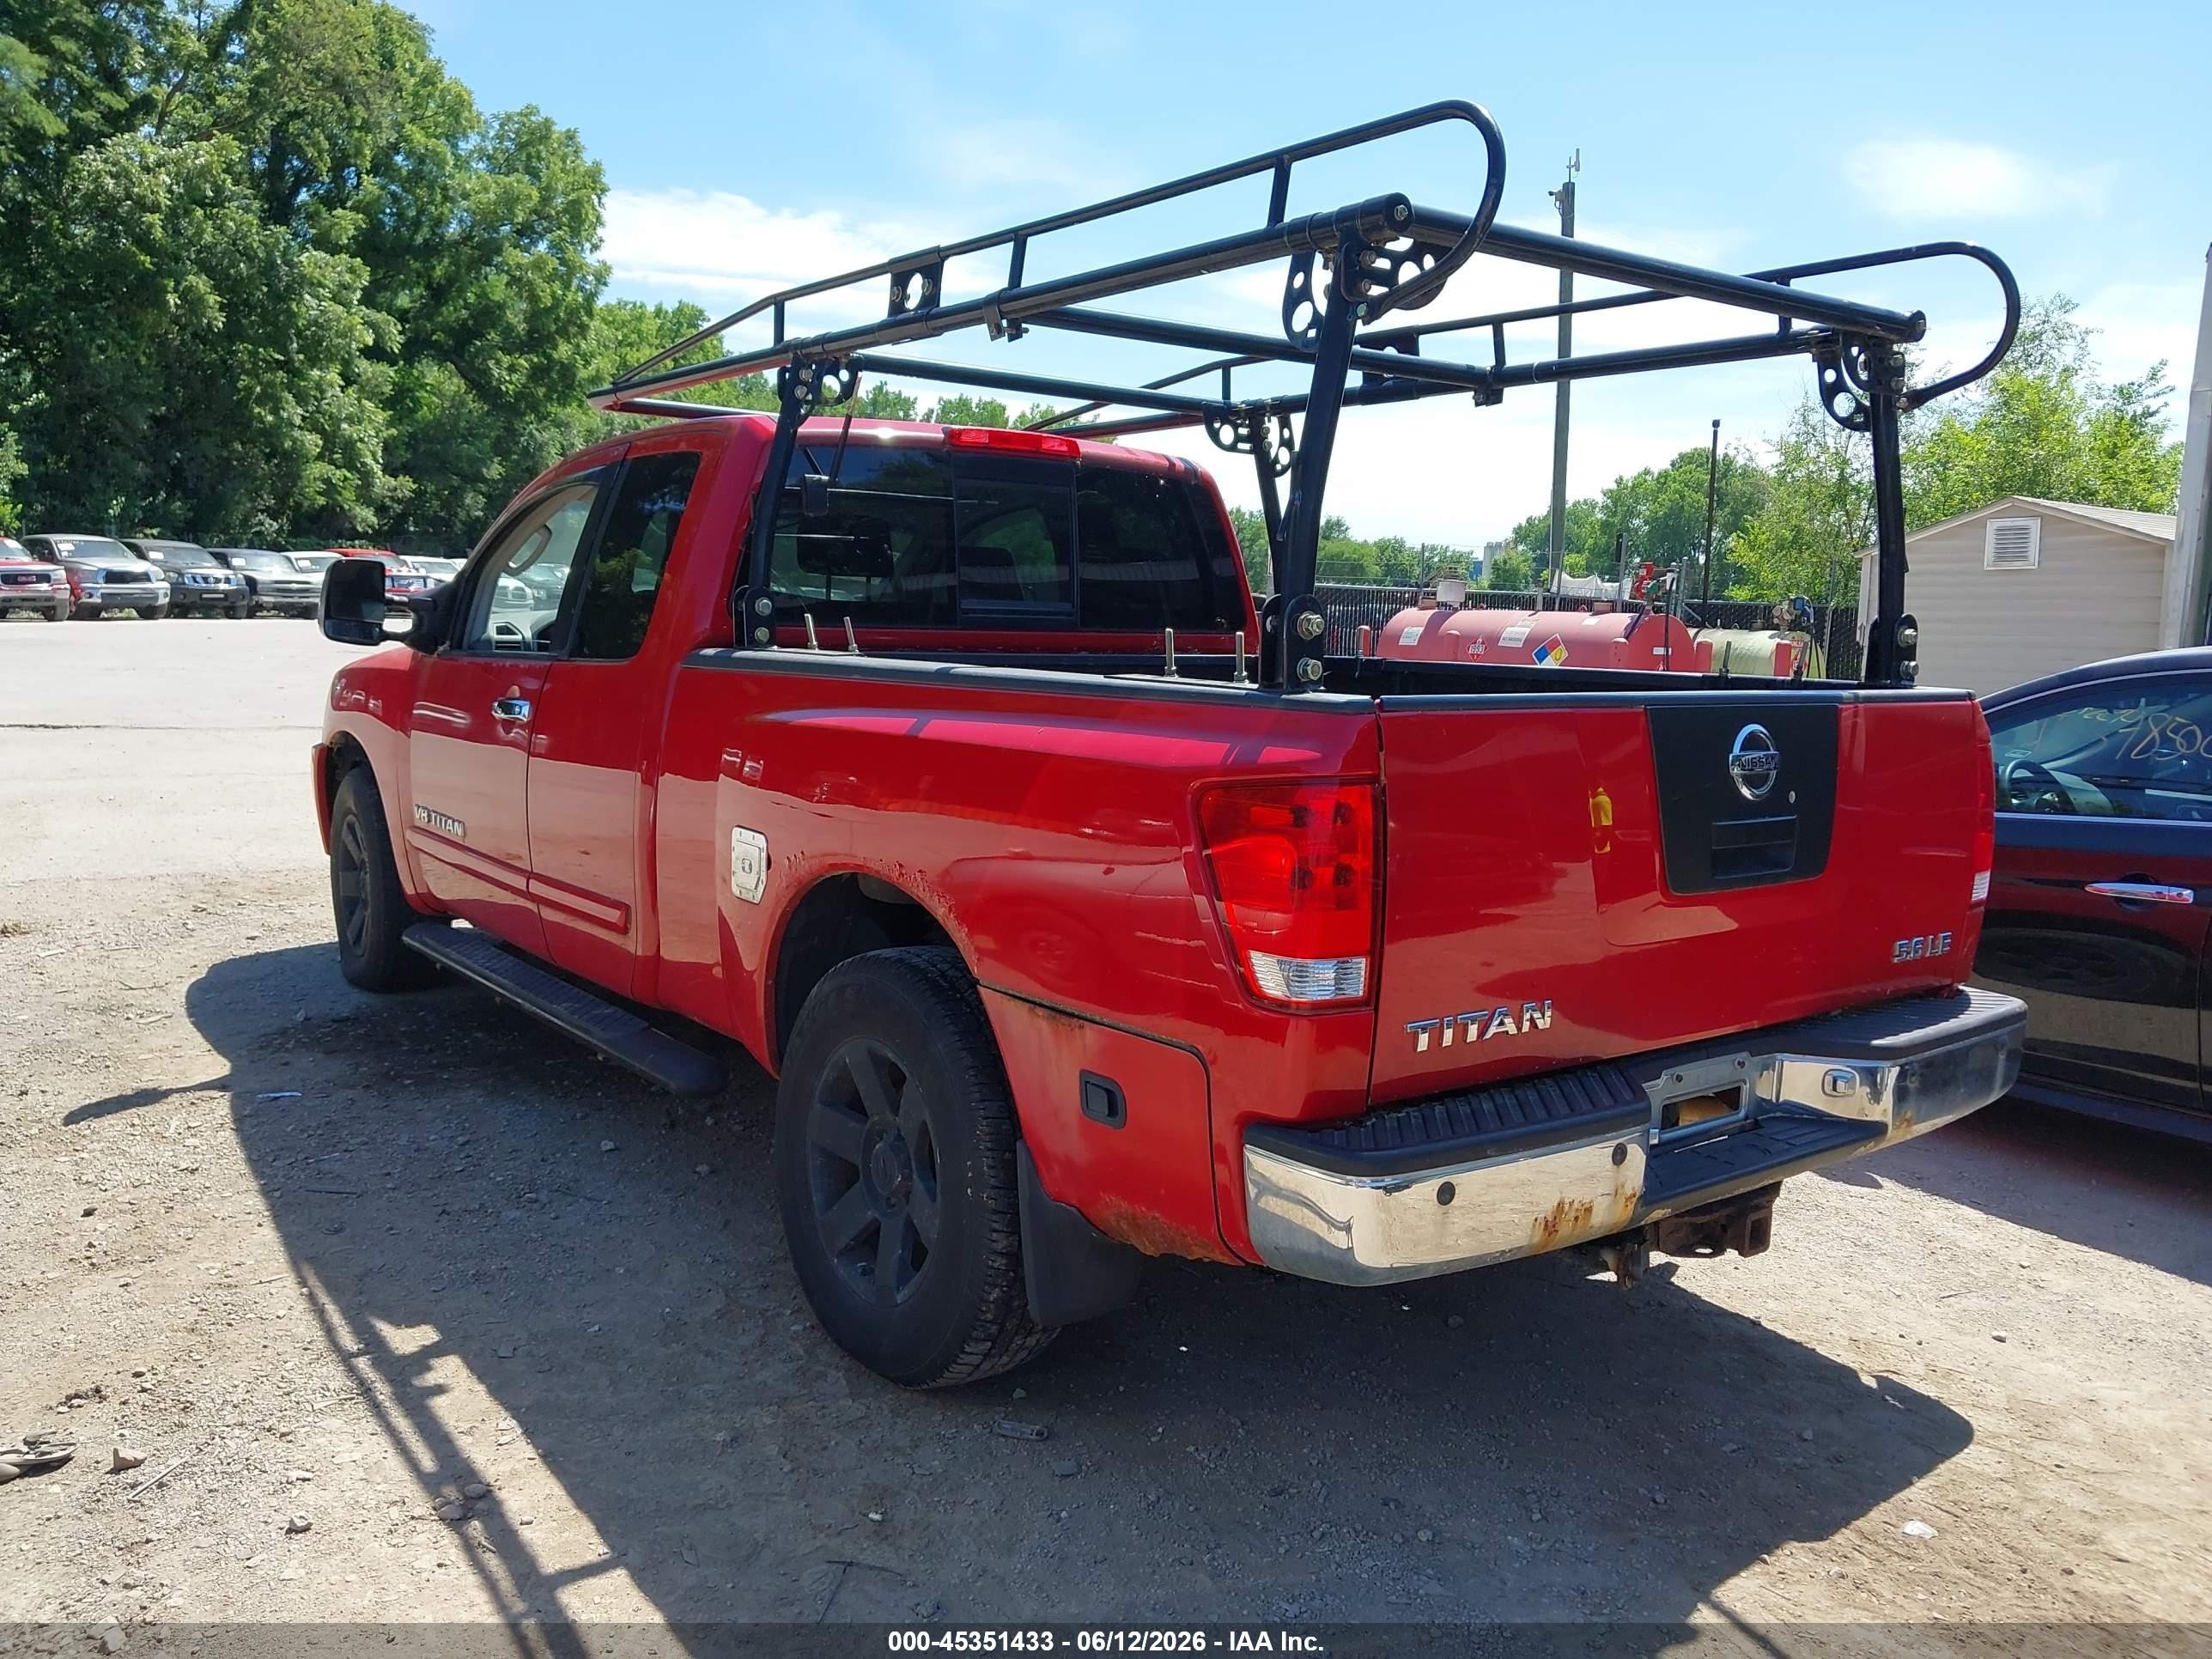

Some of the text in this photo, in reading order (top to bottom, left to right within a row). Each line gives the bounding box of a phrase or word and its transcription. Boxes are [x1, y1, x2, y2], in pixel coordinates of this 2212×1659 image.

[1470, 645, 1484, 653] 1993
[1740, 756, 1778, 770] NISSAN
[415, 805, 464, 836] V8 TITAN
[1406, 999, 1553, 1053] TITAN
